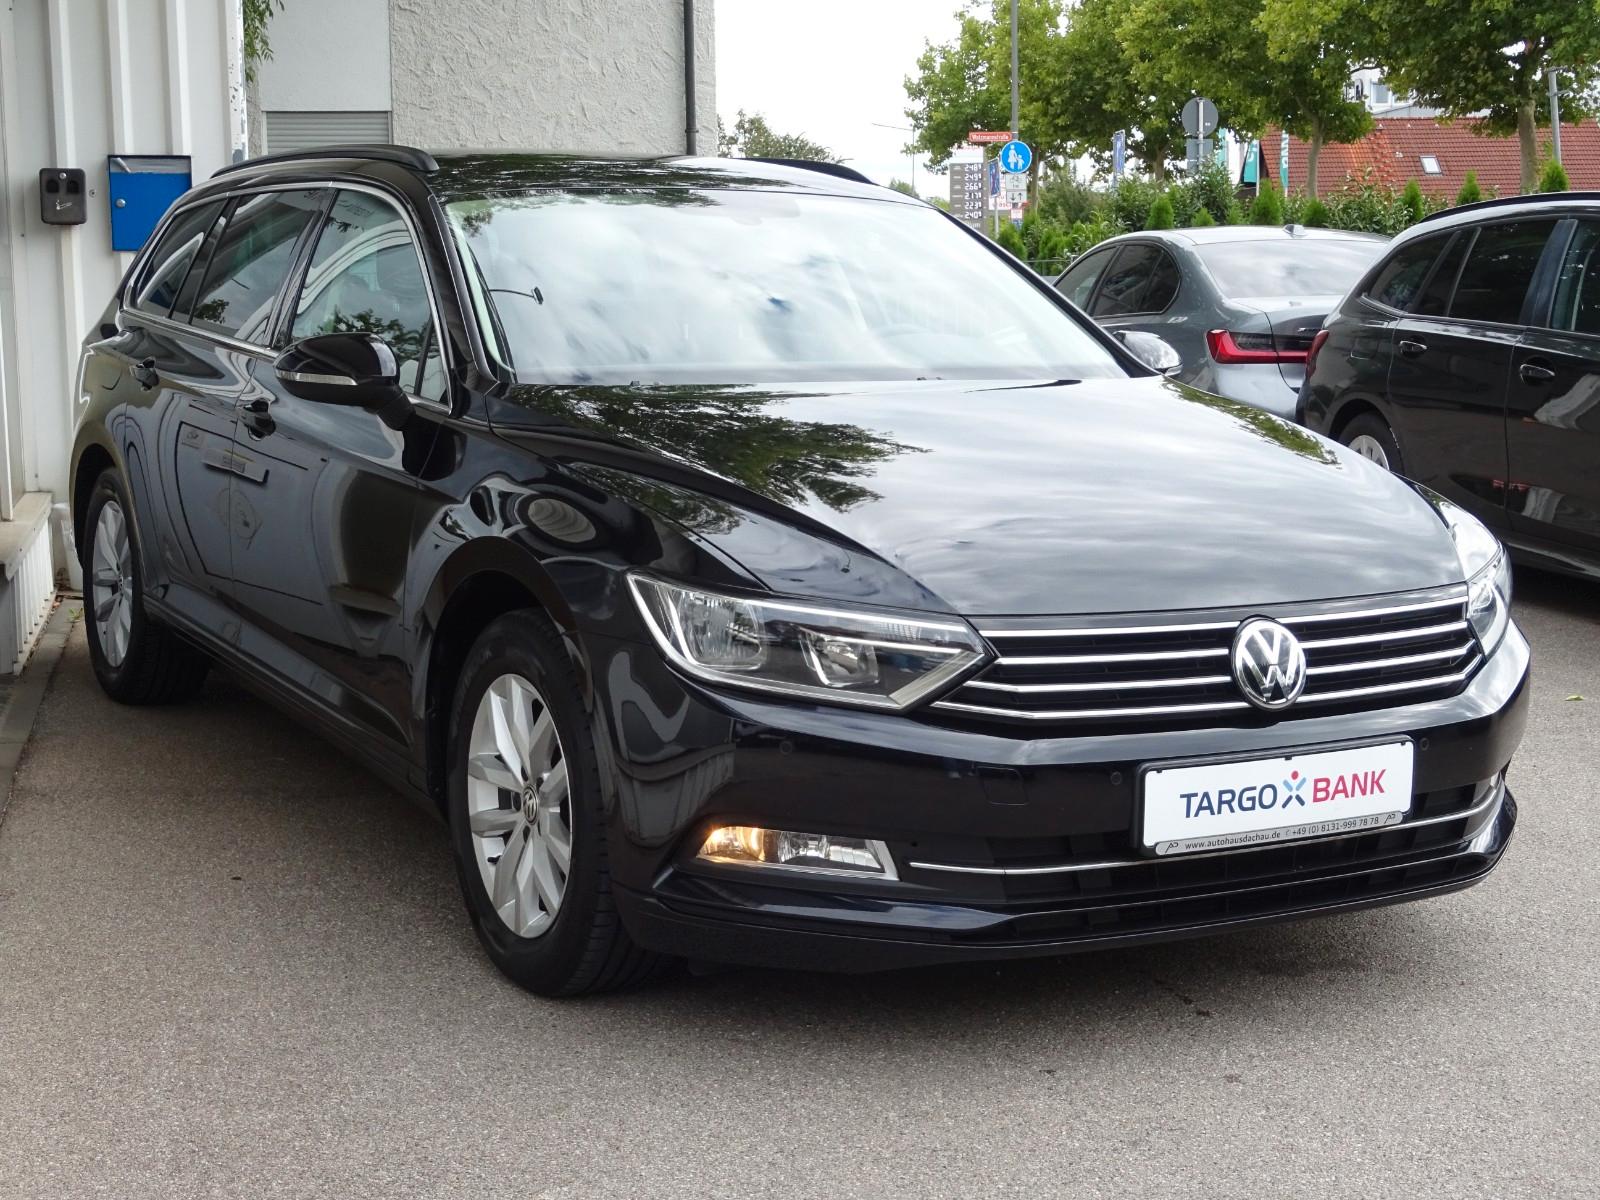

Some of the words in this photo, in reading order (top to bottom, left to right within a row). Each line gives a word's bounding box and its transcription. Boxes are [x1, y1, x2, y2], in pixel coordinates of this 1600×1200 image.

[1179, 784, 1278, 818] TARGO
[1312, 769, 1387, 803] BANK
[1185, 831, 1281, 850] www.autohausdachau.de
[1292, 826, 1306, 835] +49
[1308, 825, 1319, 835] (0)
[1321, 820, 1357, 832] 8131-999
[1359, 818, 1368, 826] 78
[1370, 816, 1379, 825] 78
